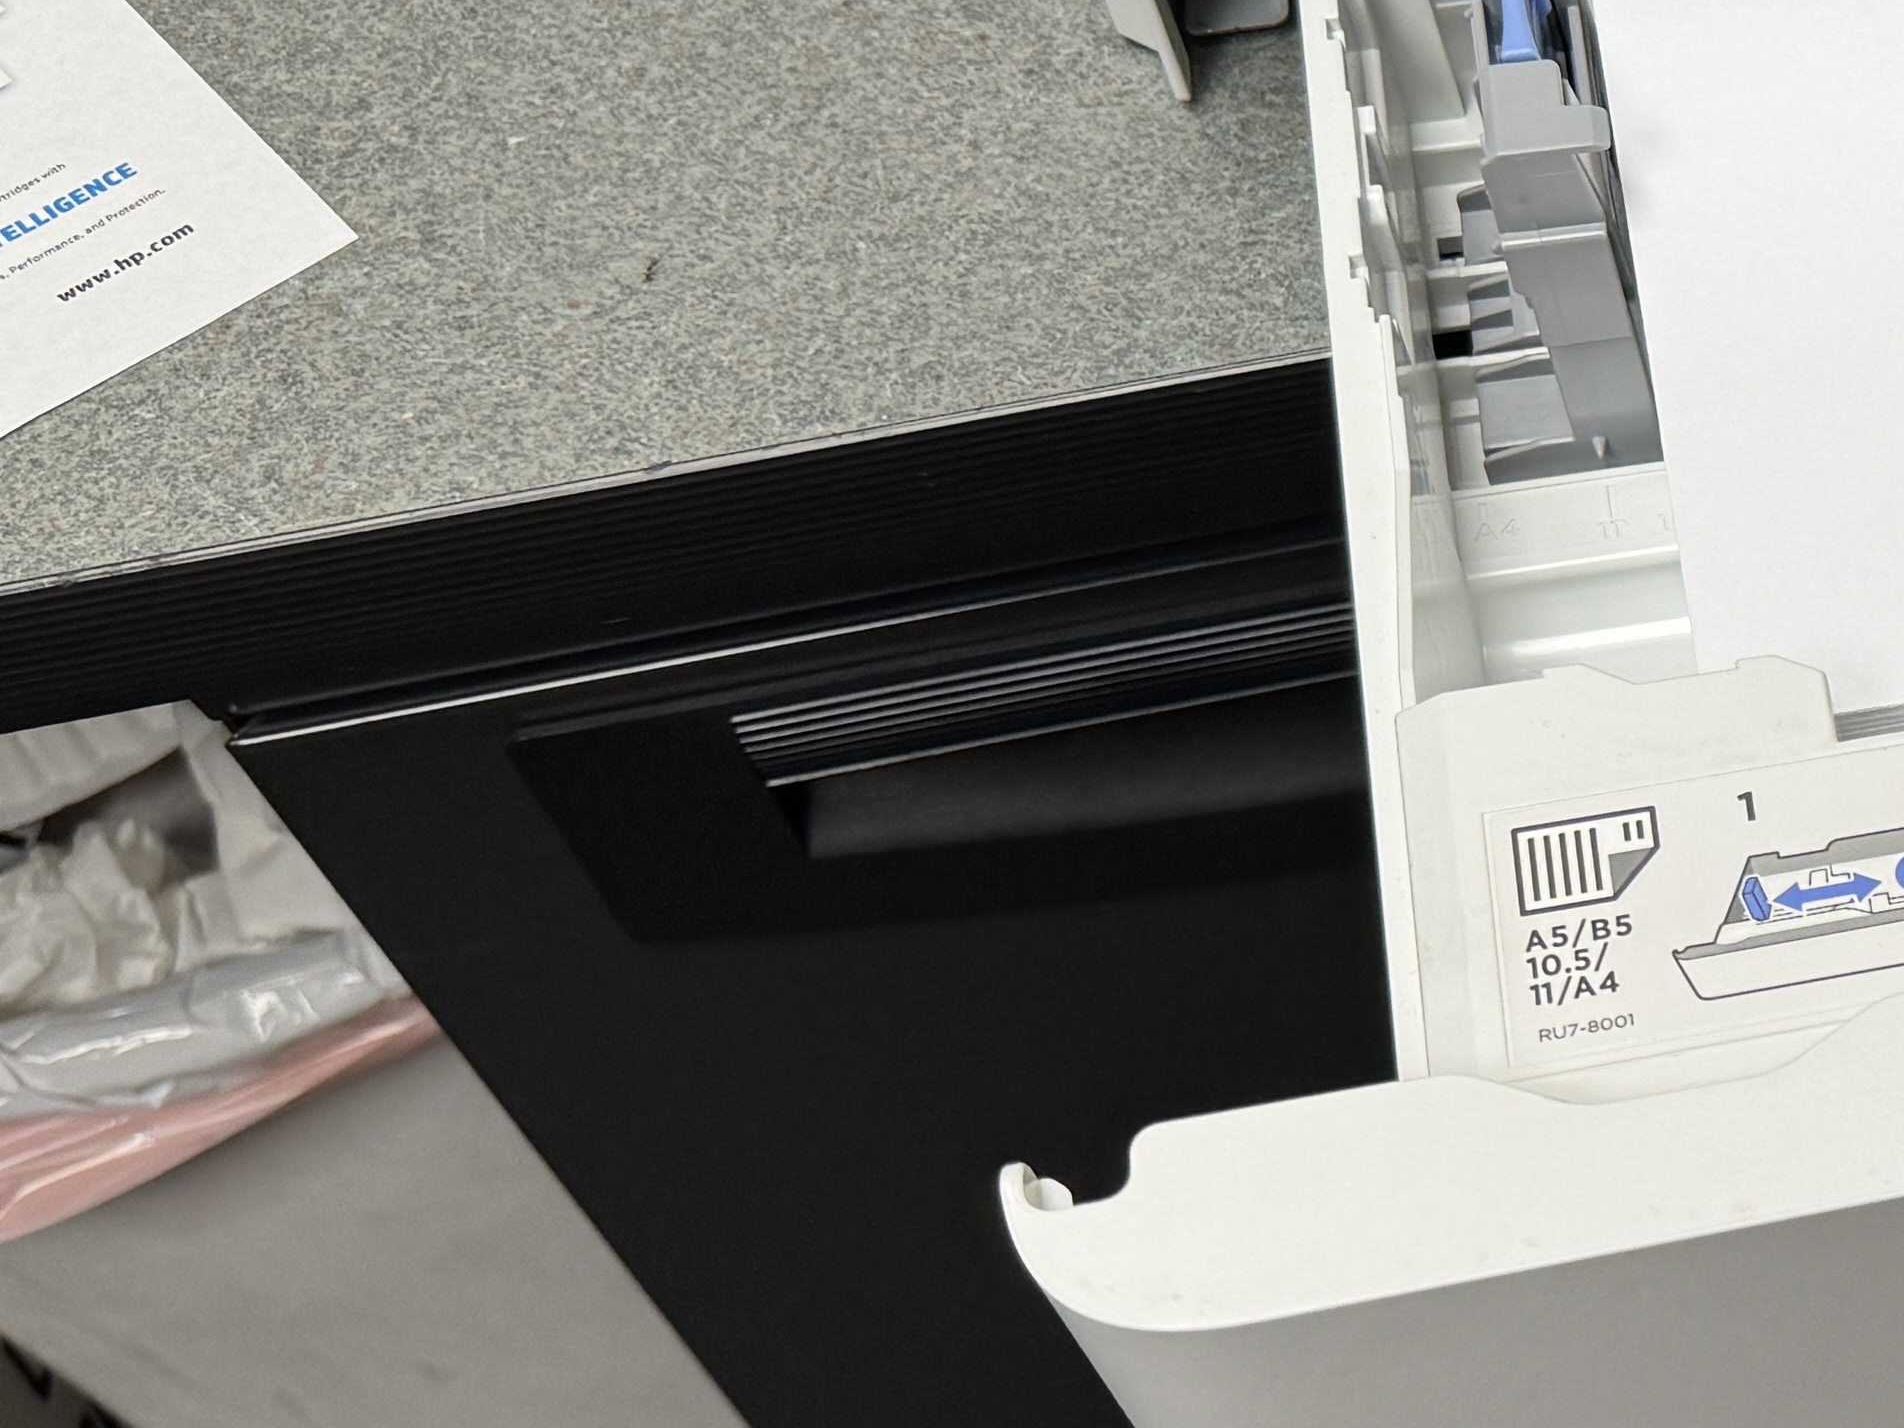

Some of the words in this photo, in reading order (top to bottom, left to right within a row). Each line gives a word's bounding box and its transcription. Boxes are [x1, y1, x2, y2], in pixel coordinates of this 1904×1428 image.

[0, 162, 138, 249] ELLIGENCE
[85, 218, 106, 236] and
[56, 223, 195, 303] www.hp.com
[1736, 791, 1758, 822] 1
[1525, 913, 1634, 954] A5/B5
[1525, 941, 1609, 980] 10.5/
[1528, 969, 1621, 1007] 11/A4
[1538, 1012, 1636, 1043] RU7-8001
